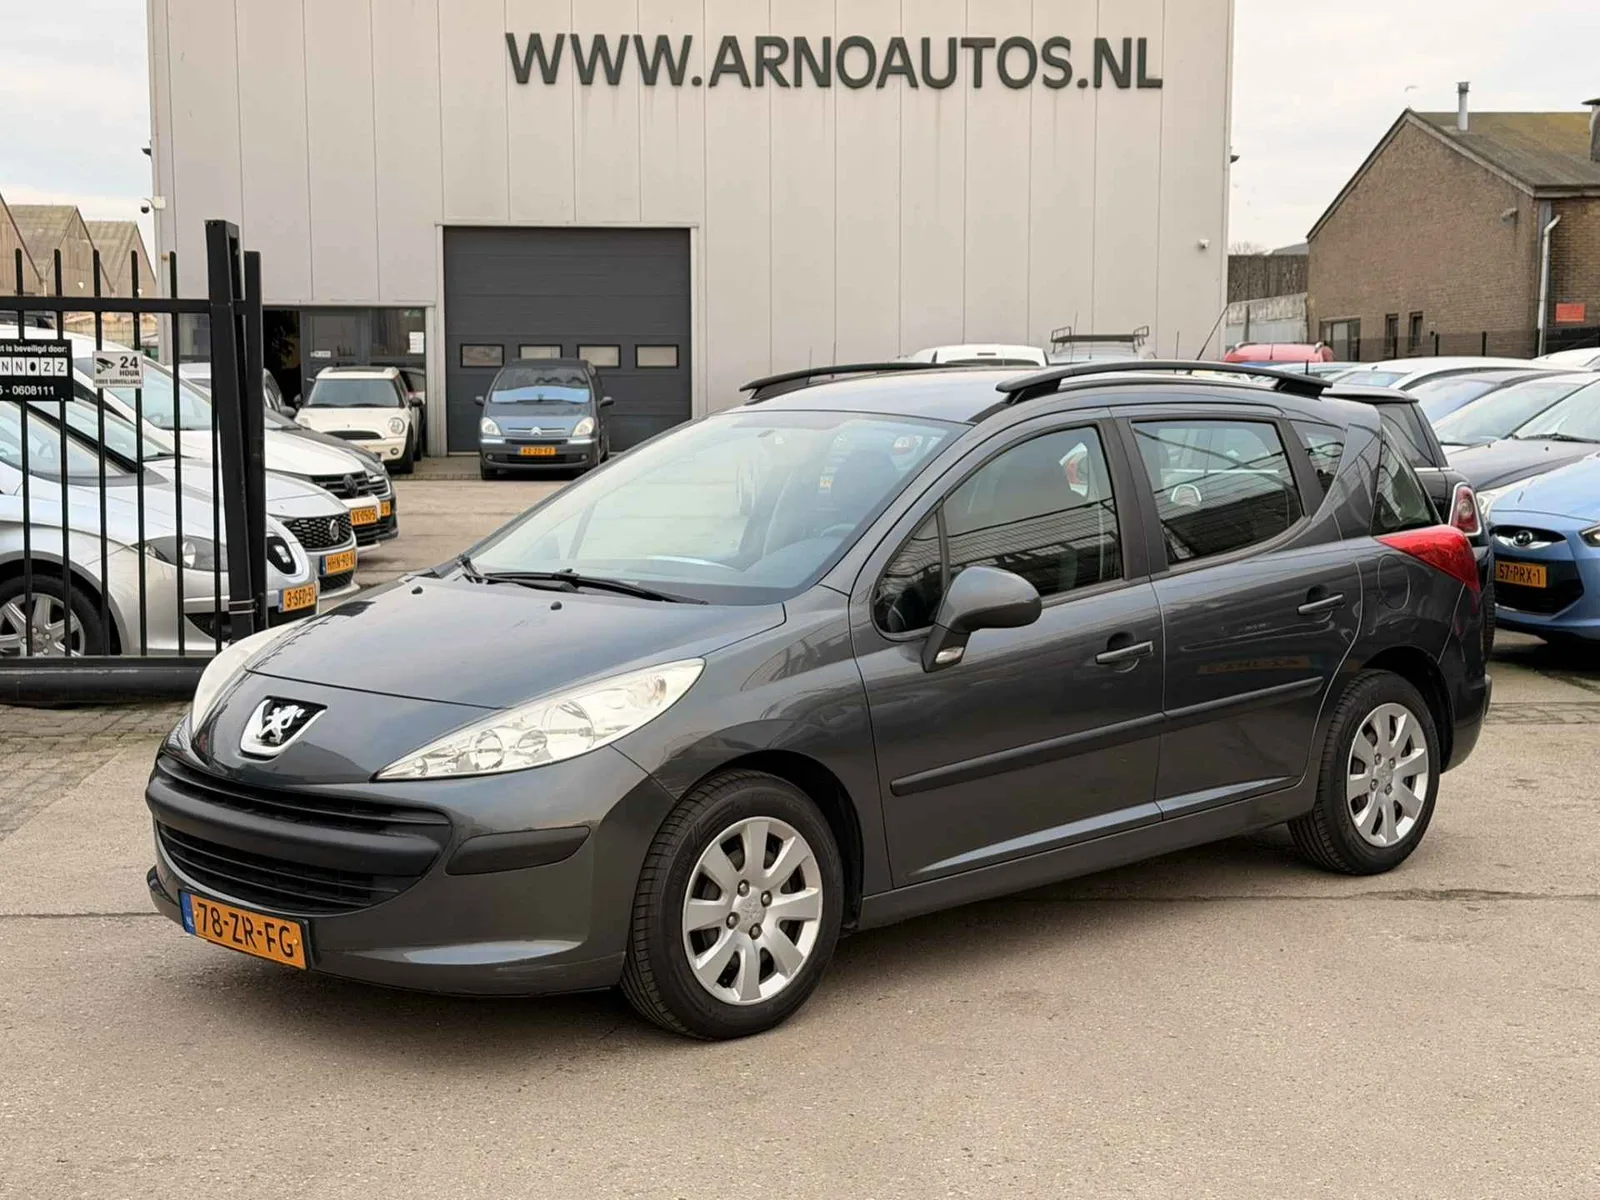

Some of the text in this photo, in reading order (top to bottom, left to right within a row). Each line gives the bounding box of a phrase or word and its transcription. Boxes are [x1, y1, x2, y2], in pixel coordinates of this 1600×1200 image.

[505, 33, 1163, 89] WWW.ARNOAUTOS.NL
[120, 356, 139, 368] 24
[12, 385, 55, 395] 0608111
[1499, 564, 1541, 585] 57-PRX-1
[197, 902, 294, 958] 78-ZR-FG
